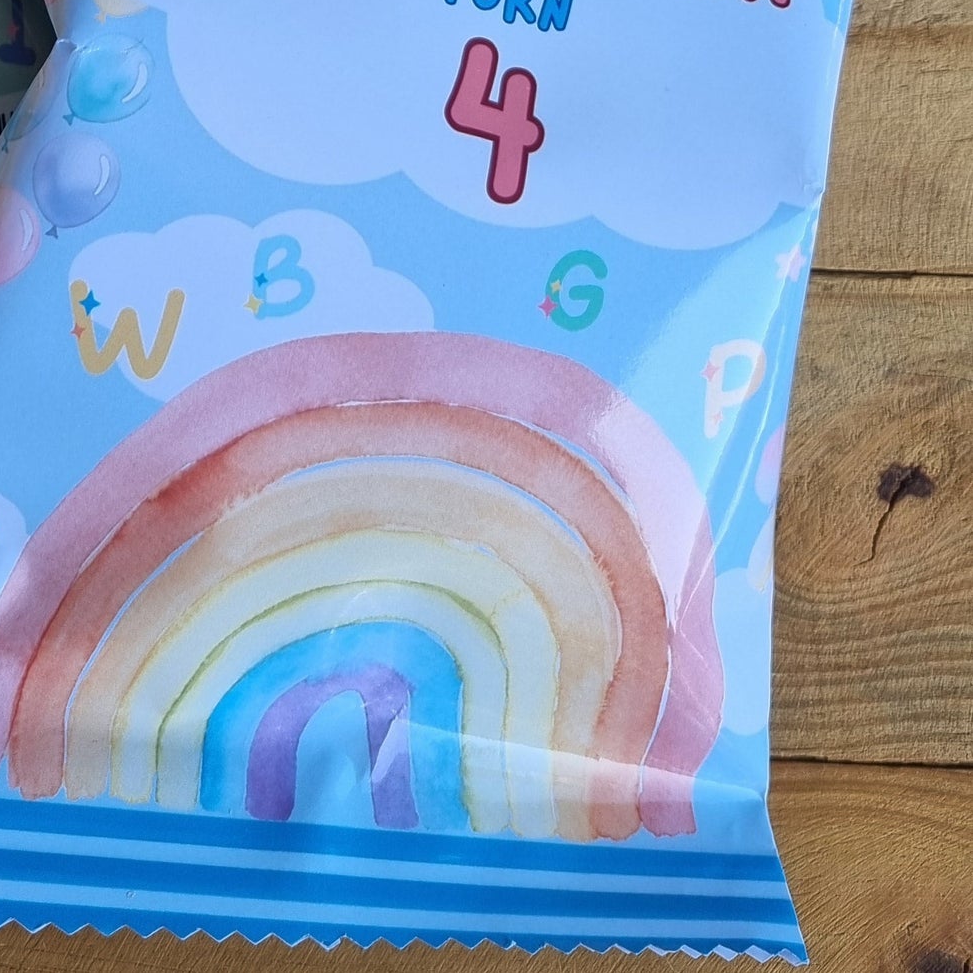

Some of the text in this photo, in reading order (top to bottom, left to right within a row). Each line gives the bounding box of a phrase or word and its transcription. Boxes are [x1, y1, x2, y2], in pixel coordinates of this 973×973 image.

[444, 36, 545, 205] 4
[252, 234, 316, 319] B
[545, 249, 609, 332] G
[69, 279, 186, 380] W
[703, 338, 767, 439] P
